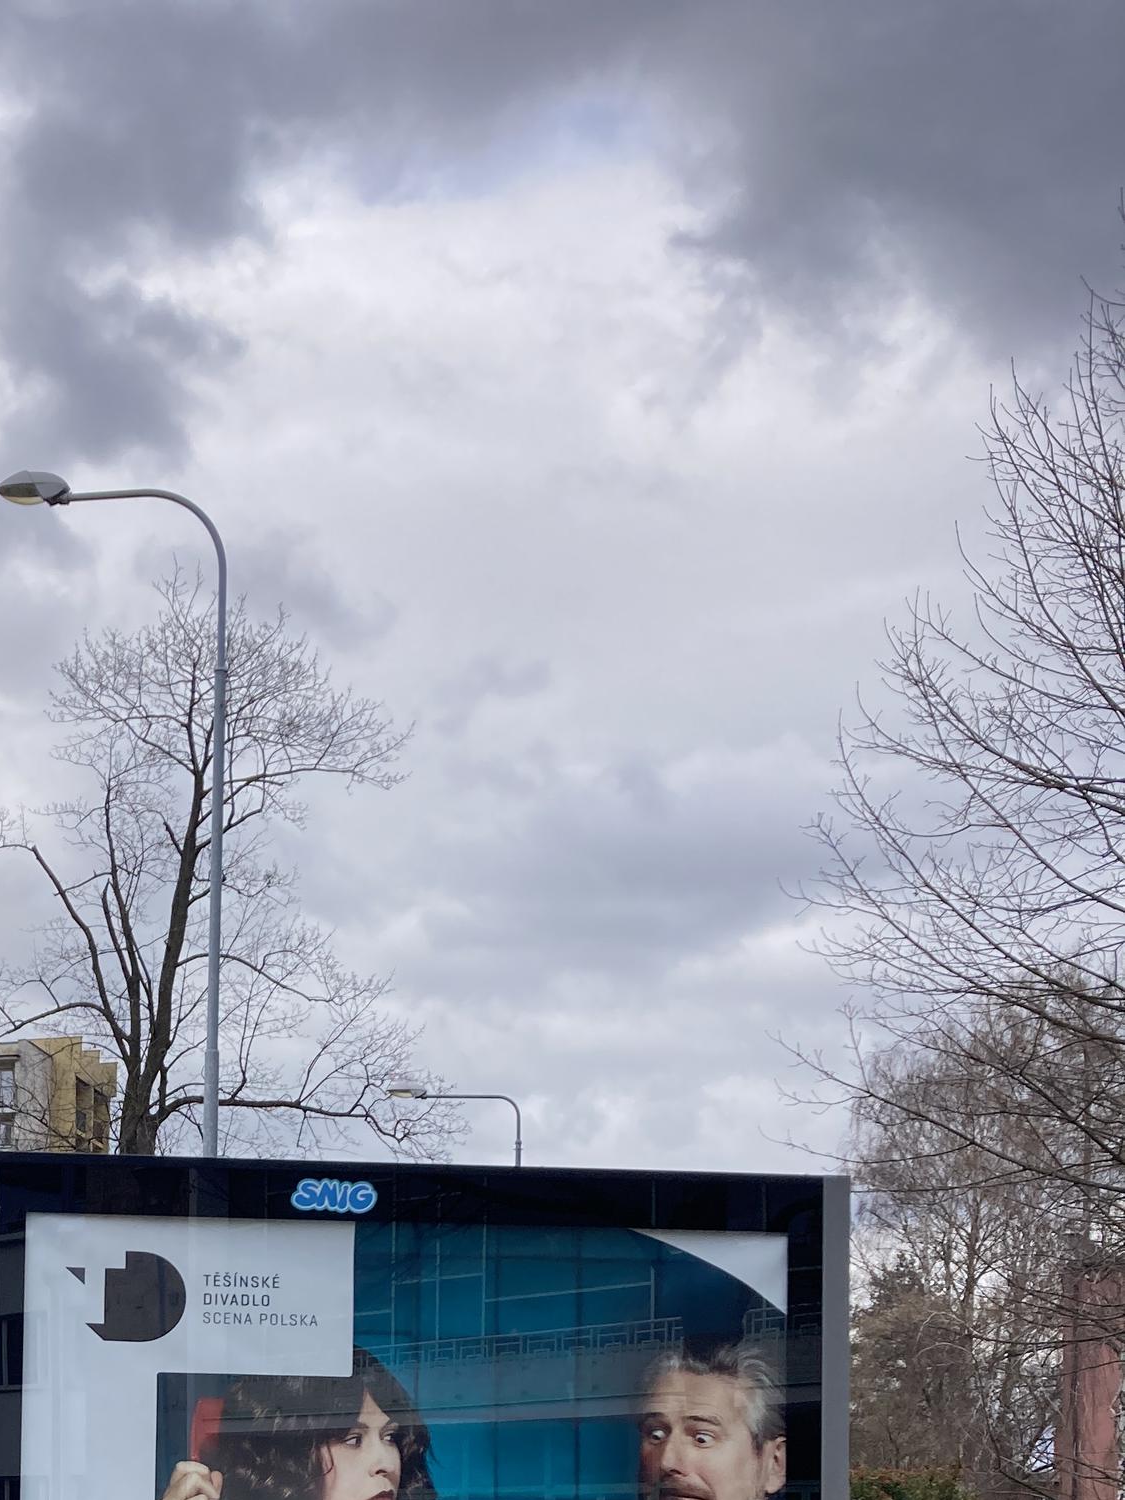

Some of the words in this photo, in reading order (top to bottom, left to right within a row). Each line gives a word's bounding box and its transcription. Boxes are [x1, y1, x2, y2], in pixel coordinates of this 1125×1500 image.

[203, 1272, 279, 1288] TĚŠÍNSKÉ
[204, 1293, 269, 1306] DIVADLO
[203, 1312, 252, 1324] SCENA
[260, 1313, 317, 1326] POLSKA
